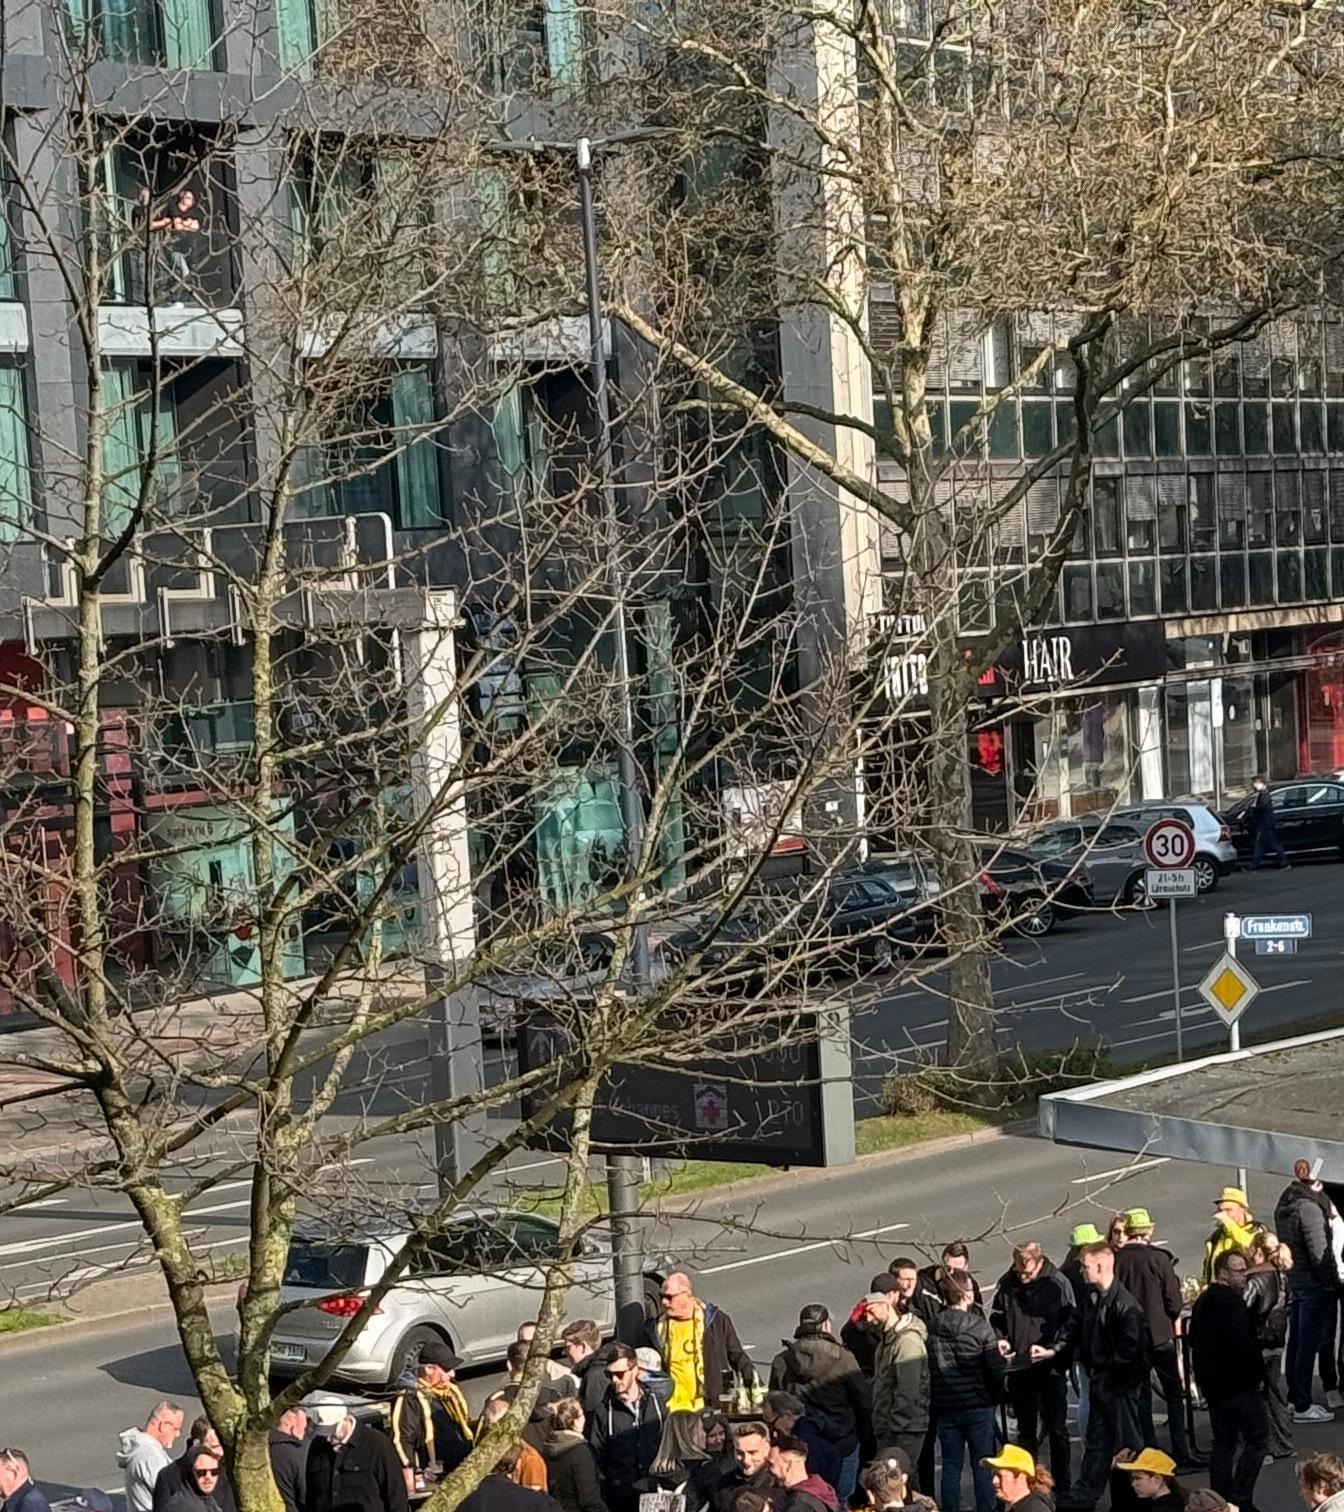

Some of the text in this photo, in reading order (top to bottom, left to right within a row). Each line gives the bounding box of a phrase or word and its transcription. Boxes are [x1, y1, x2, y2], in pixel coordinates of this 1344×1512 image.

[1022, 636, 1075, 685] HAIR
[1156, 834, 1184, 857] 30
[1266, 940, 1286, 953] 2-6
